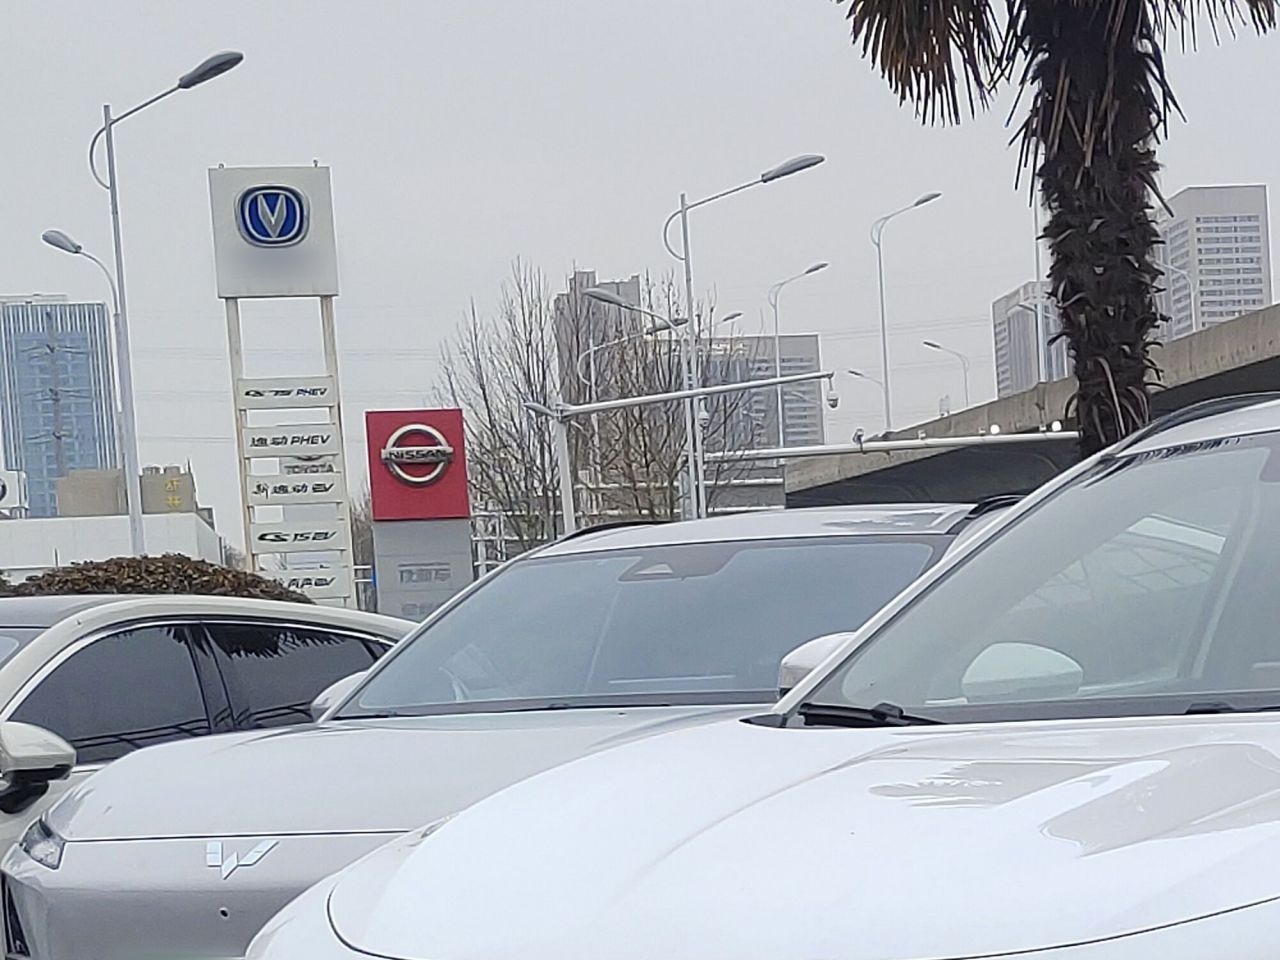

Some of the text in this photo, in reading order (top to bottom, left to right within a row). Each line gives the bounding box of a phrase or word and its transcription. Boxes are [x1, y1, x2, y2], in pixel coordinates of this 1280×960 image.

[290, 435, 331, 446] PHEV
[389, 449, 447, 460] NISSAN
[283, 463, 335, 474] TOYOTA
